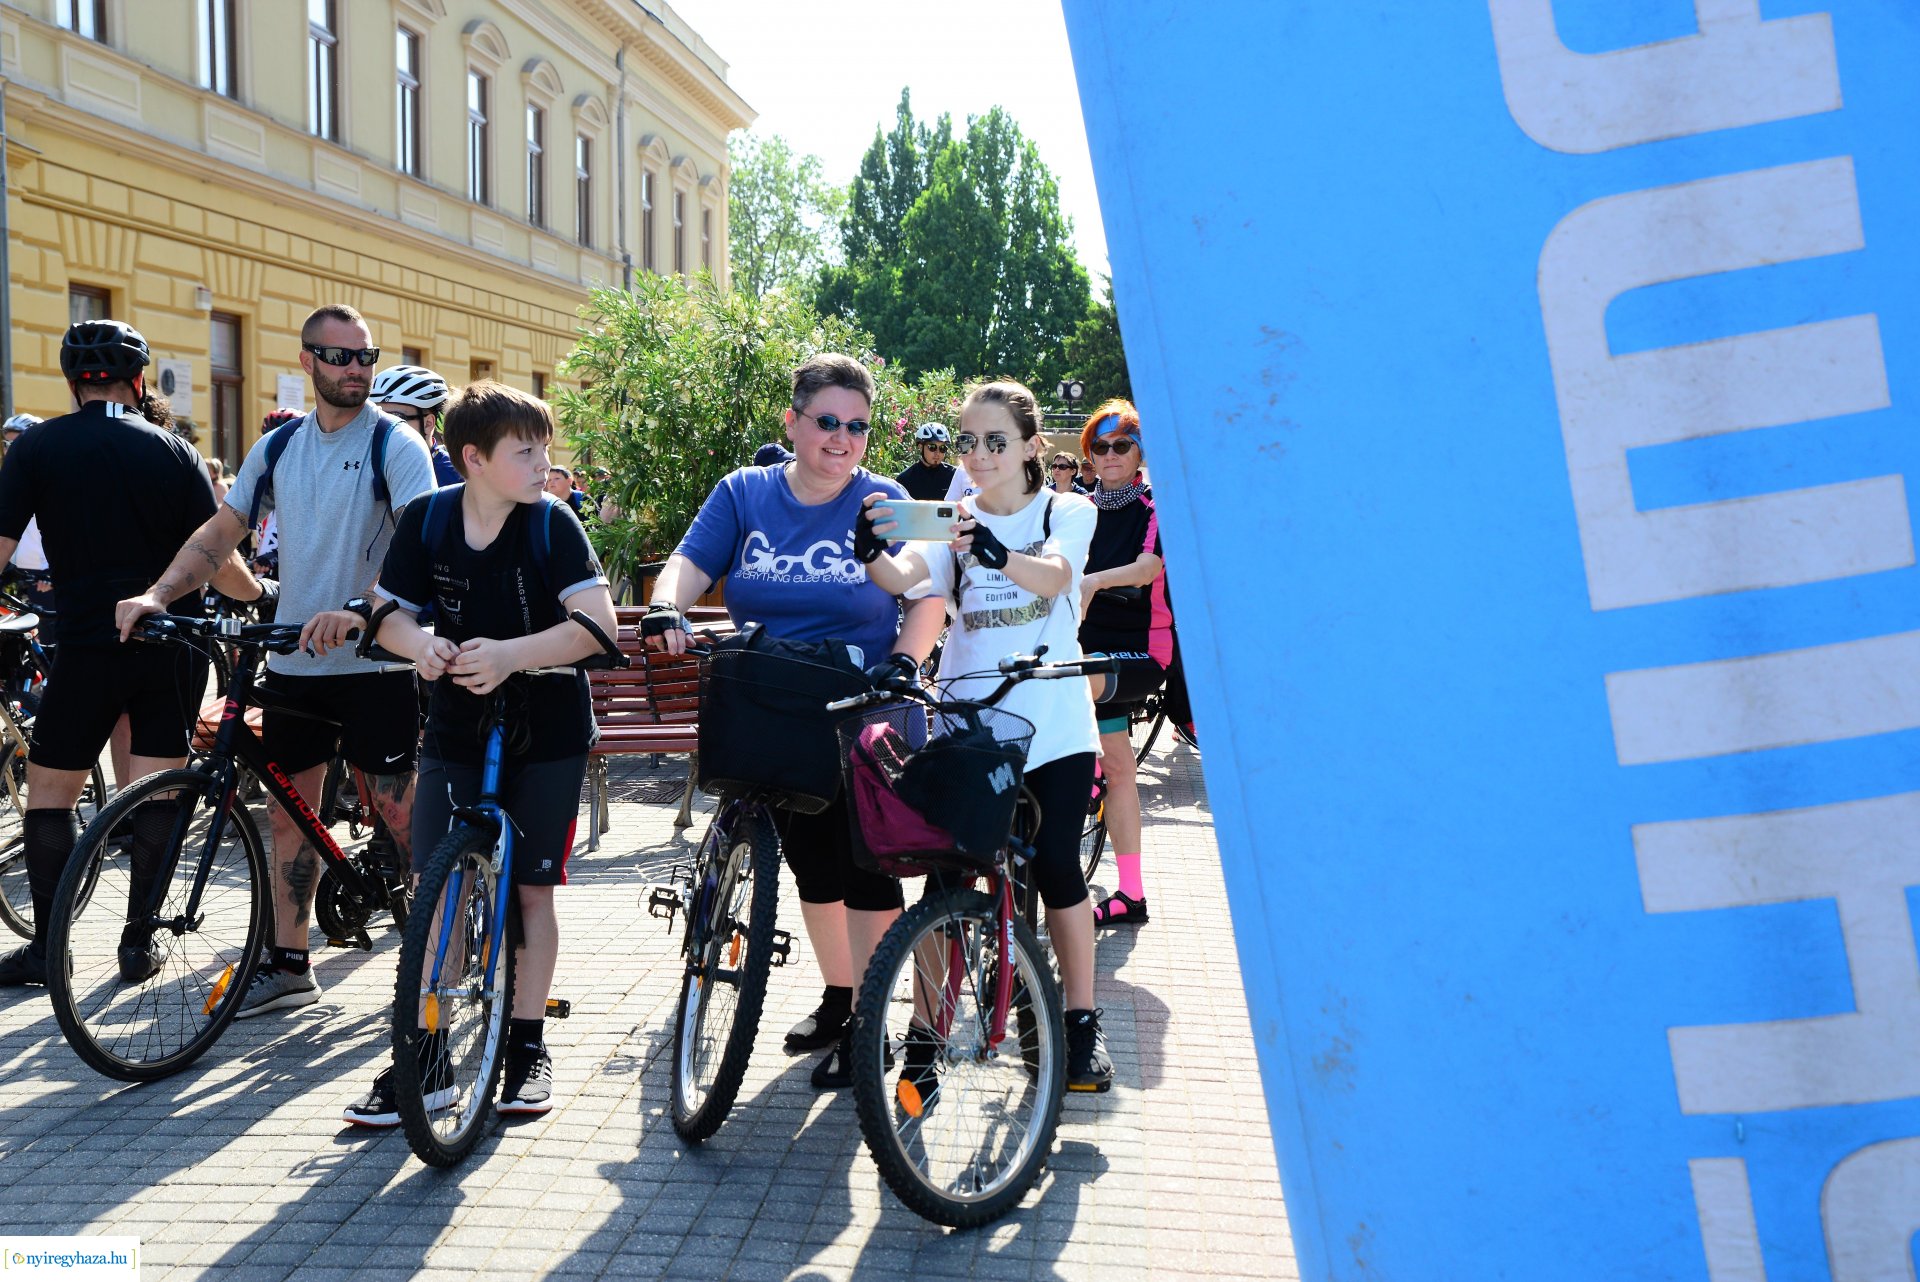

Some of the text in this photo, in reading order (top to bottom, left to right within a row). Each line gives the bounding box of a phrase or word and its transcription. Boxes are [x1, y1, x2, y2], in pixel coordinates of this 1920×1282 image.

[986, 573, 1009, 582] LIMIT
[985, 590, 1018, 602] EDITION
[266, 761, 347, 861] cannondale
